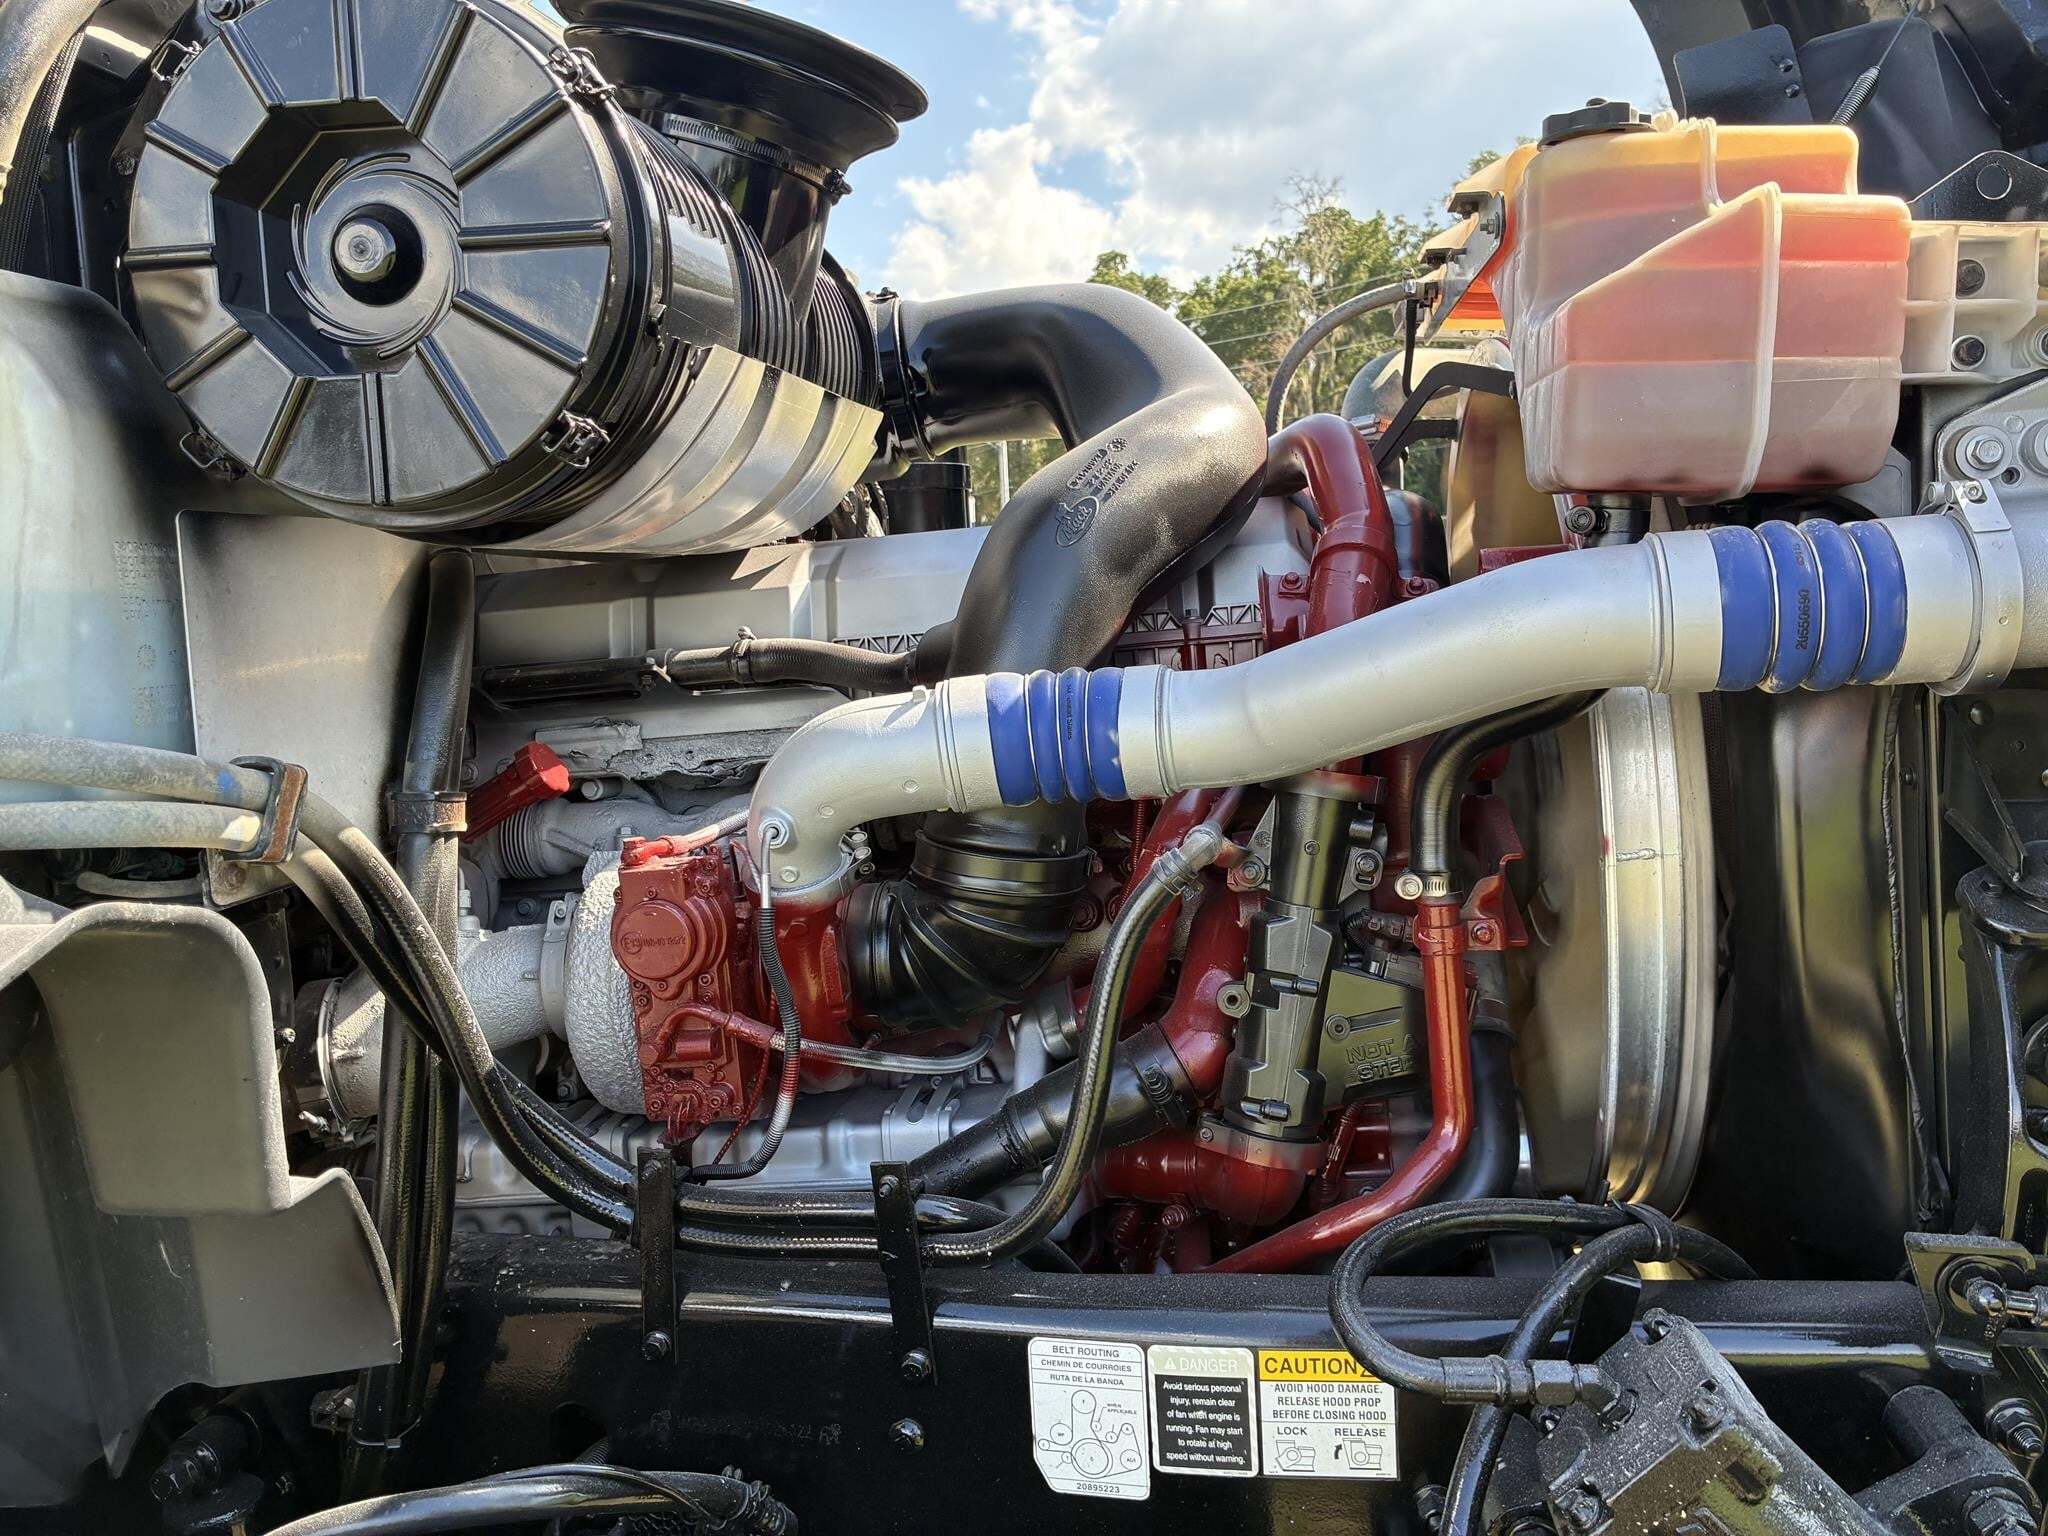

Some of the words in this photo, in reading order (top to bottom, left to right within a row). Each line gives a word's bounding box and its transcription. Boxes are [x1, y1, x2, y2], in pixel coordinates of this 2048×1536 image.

[1346, 1038, 1394, 1064] NOT
[1052, 1345, 1075, 1354] BELT
[1077, 1347, 1120, 1358] ROUTING
[1041, 1359, 1071, 1368] CHEMIN
[1072, 1361, 1084, 1369] DE
[1085, 1362, 1132, 1373] COURROIES
[1180, 1358, 1238, 1372] DANGER
[1264, 1357, 1357, 1375] CAUTION
[1050, 1373, 1070, 1382] RUTA
[1072, 1375, 1083, 1383] DE
[1084, 1376, 1096, 1384] LA
[1097, 1377, 1125, 1386] BANDA
[1163, 1381, 1183, 1391] Avoid
[1183, 1383, 1210, 1392] serious
[1210, 1384, 1242, 1393] personal
[1274, 1383, 1304, 1393] AVOID
[1306, 1383, 1335, 1394] HOOD
[1192, 1398, 1217, 1407] remain
[1217, 1398, 1236, 1407] clear
[1277, 1396, 1320, 1407] RELEASE
[1322, 1397, 1352, 1407] HOOD
[1354, 1398, 1381, 1408] PROP
[1188, 1410, 1208, 1419] when
[1208, 1412, 1233, 1422] engine
[1233, 1412, 1241, 1421] is
[1272, 1409, 1310, 1420] BEFORE
[1312, 1410, 1356, 1420] CLOSING
[1359, 1411, 1387, 1421] HOOD
[1165, 1424, 1194, 1434] running.
[1195, 1425, 1209, 1434] Fan
[1210, 1427, 1226, 1436] may
[1226, 1427, 1243, 1436] start
[1277, 1426, 1308, 1436] LOCK
[1334, 1427, 1387, 1437] RELEASE
[1177, 1438, 1185, 1447] to
[1186, 1439, 1208, 1448] rotate
[1216, 1440, 1233, 1450] high
[1166, 1452, 1188, 1461] speed
[1189, 1453, 1215, 1462] without
[1215, 1455, 1246, 1465] warning.
[1076, 1482, 1120, 1494] 20895223
